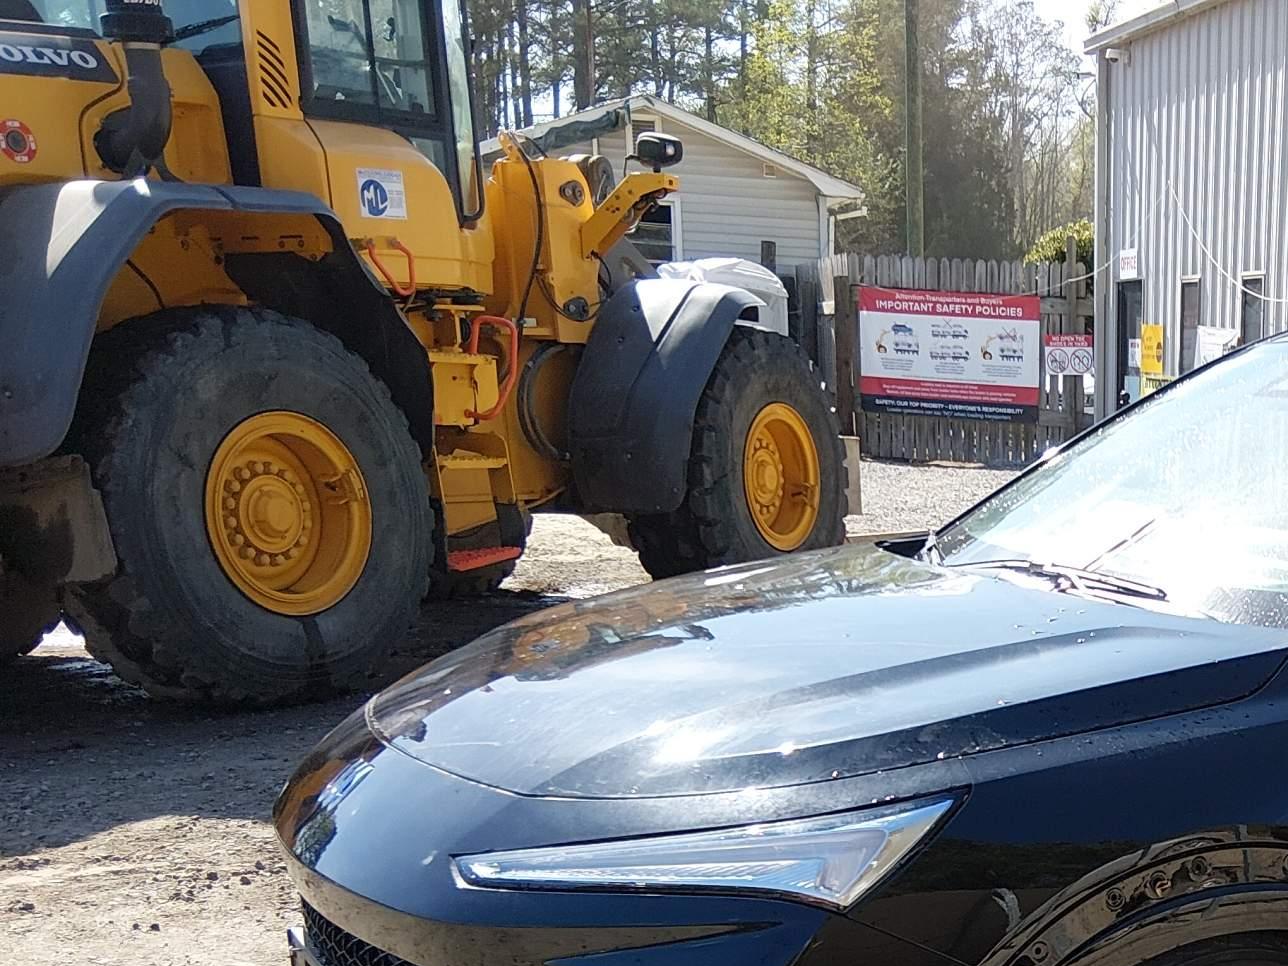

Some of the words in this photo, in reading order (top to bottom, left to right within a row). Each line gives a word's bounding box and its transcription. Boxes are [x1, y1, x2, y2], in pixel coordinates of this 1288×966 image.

[0, 44, 98, 69] OLVO
[1121, 255, 1136, 272] OFFICE
[875, 299, 933, 312] IMPORTANT
[936, 303, 973, 315] SAFETY
[975, 304, 1023, 317] POLICIES
[981, 405, 1024, 415] RESPONSIBILITY
